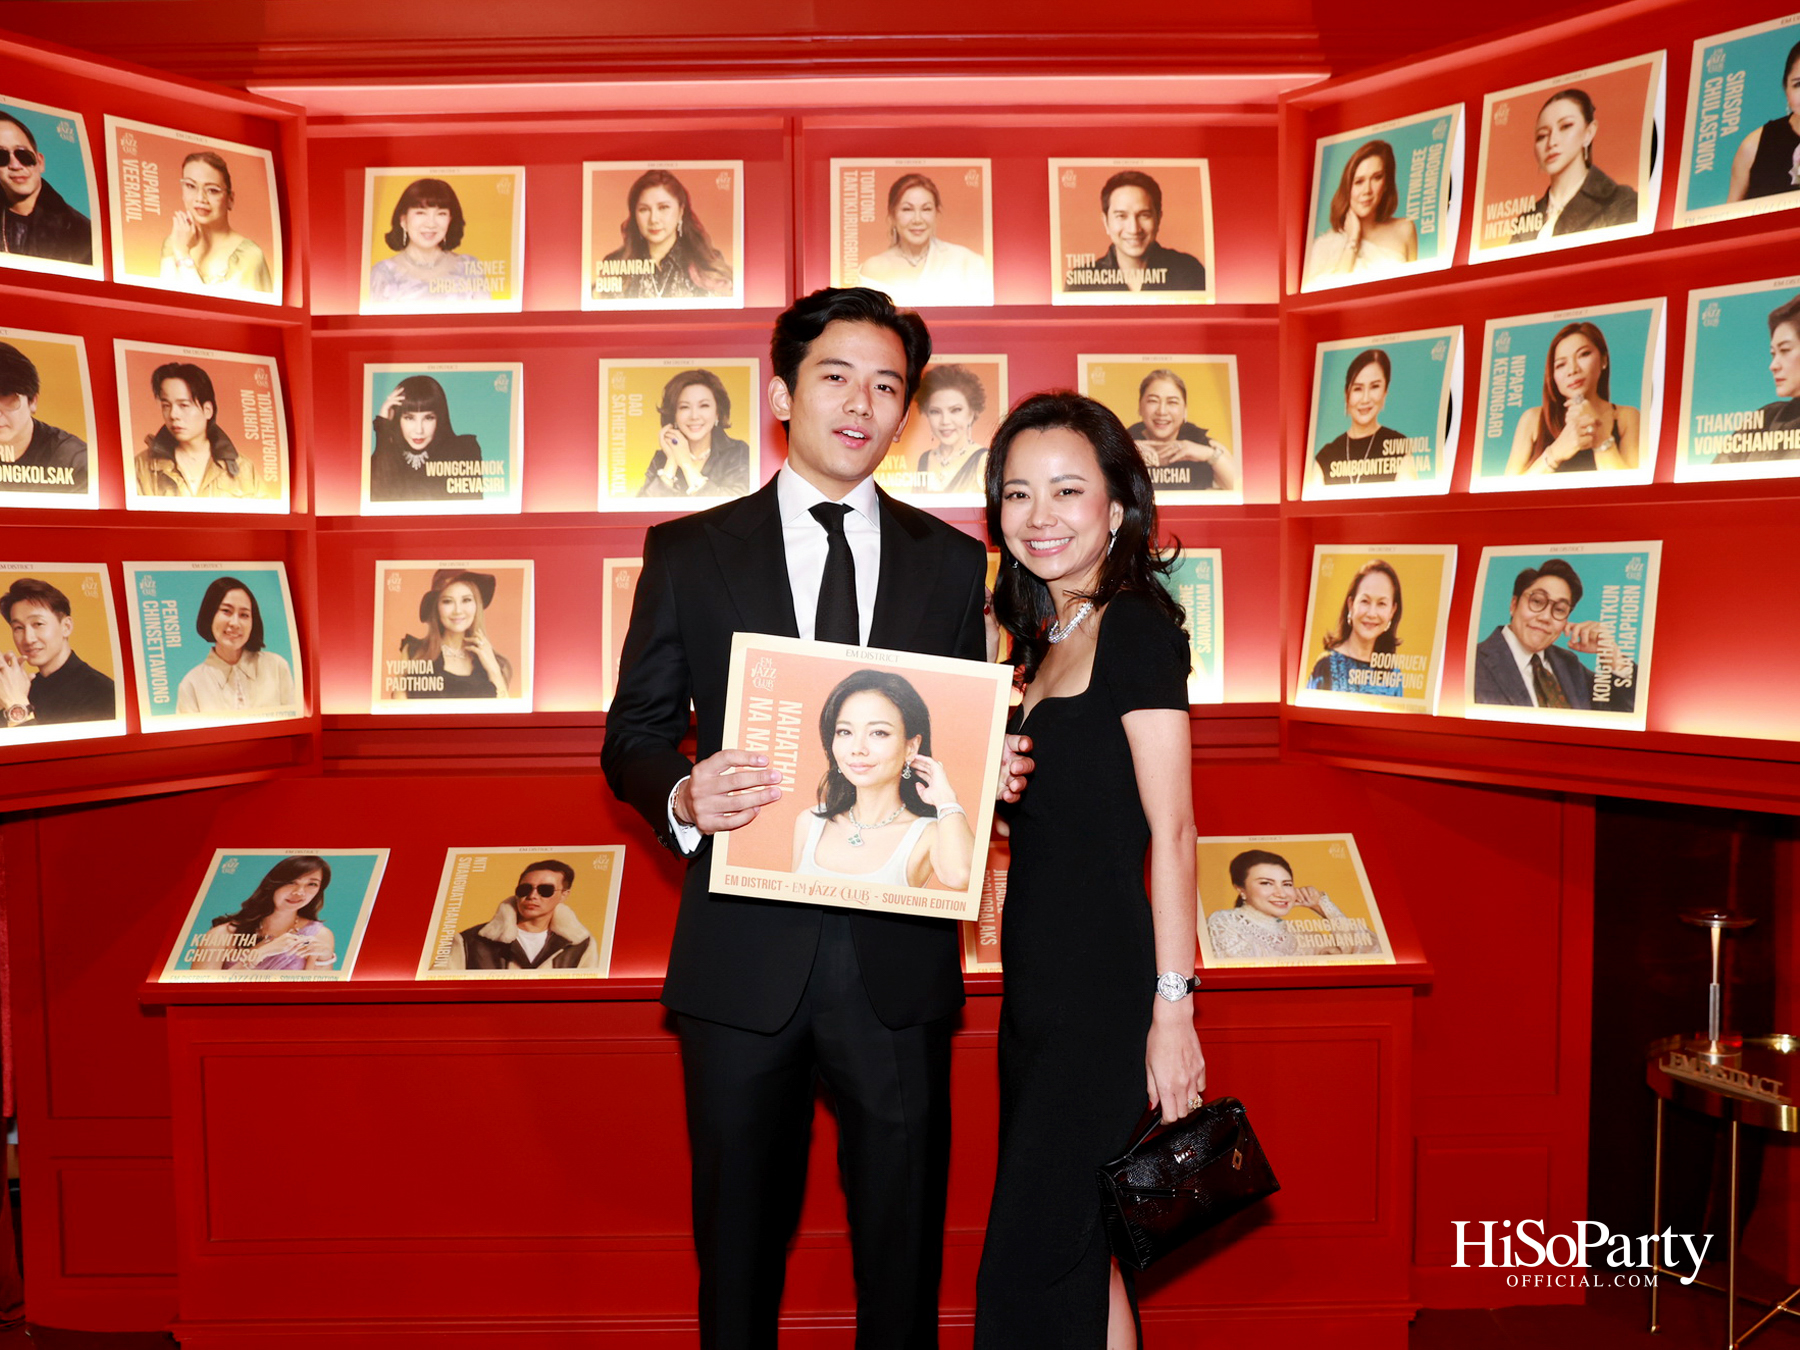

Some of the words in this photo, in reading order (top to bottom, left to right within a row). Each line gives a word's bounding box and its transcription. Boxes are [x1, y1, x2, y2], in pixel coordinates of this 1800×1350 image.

[1720, 70, 1746, 137] SIRISOPA
[1694, 77, 1723, 174] CHULASEWOK
[122, 159, 142, 223] VEERAKUL
[142, 162, 161, 215] SUPANIT
[1406, 146, 1428, 221] KITTIWADEE
[1421, 143, 1443, 235] DEJTHAMRONG
[860, 170, 875, 223] TOMTONG
[1486, 195, 1536, 221] WASANA
[1484, 212, 1543, 240] INTASANG
[464, 260, 505, 275] TASNEE
[595, 259, 656, 276] PAWANRAT
[1066, 253, 1095, 268] THITI
[595, 277, 622, 293] BURI
[1507, 354, 1526, 408] NIPAPAT
[628, 393, 643, 417] DAO
[1488, 357, 1509, 438] KEWONGARD
[241, 390, 259, 440] SURIYON
[1695, 410, 1765, 434] THAKORN
[257, 392, 278, 483] SRIORATHAIKUL
[1382, 436, 1431, 456] SUWIMOL
[425, 460, 505, 477] WONGCHANOK
[446, 477, 505, 494] CHEVASIRI
[161, 600, 181, 648] PENSIRI
[1196, 583, 1211, 654] SAVANKHAM
[143, 600, 170, 704] CHINSETTAWONG
[1593, 585, 1620, 702] KONGTHANATKUN
[386, 659, 434, 675] YUPINDA
[760, 657, 773, 667] EM
[845, 649, 859, 658] EM
[860, 650, 900, 663] DISTRICT
[1370, 652, 1427, 671] BOONRUEN
[751, 662, 776, 679] JAZZ
[1348, 670, 1424, 689] SRIFUENGFUNG
[386, 676, 444, 692] PADTHONG
[752, 677, 774, 691] CLUB
[748, 696, 773, 722] NA
[472, 857, 488, 873] NITI
[725, 874, 740, 886] EM
[741, 875, 783, 891] DISTRICT
[792, 881, 807, 894] EM
[808, 880, 838, 897] JAZZ
[840, 886, 870, 905] CLUB
[882, 892, 928, 907] SOUVENIR
[930, 898, 966, 912] EDITION
[190, 933, 259, 947] KHANITHA
[1297, 933, 1373, 948] CHOMANAN
[1669, 1052, 1697, 1073] EM
